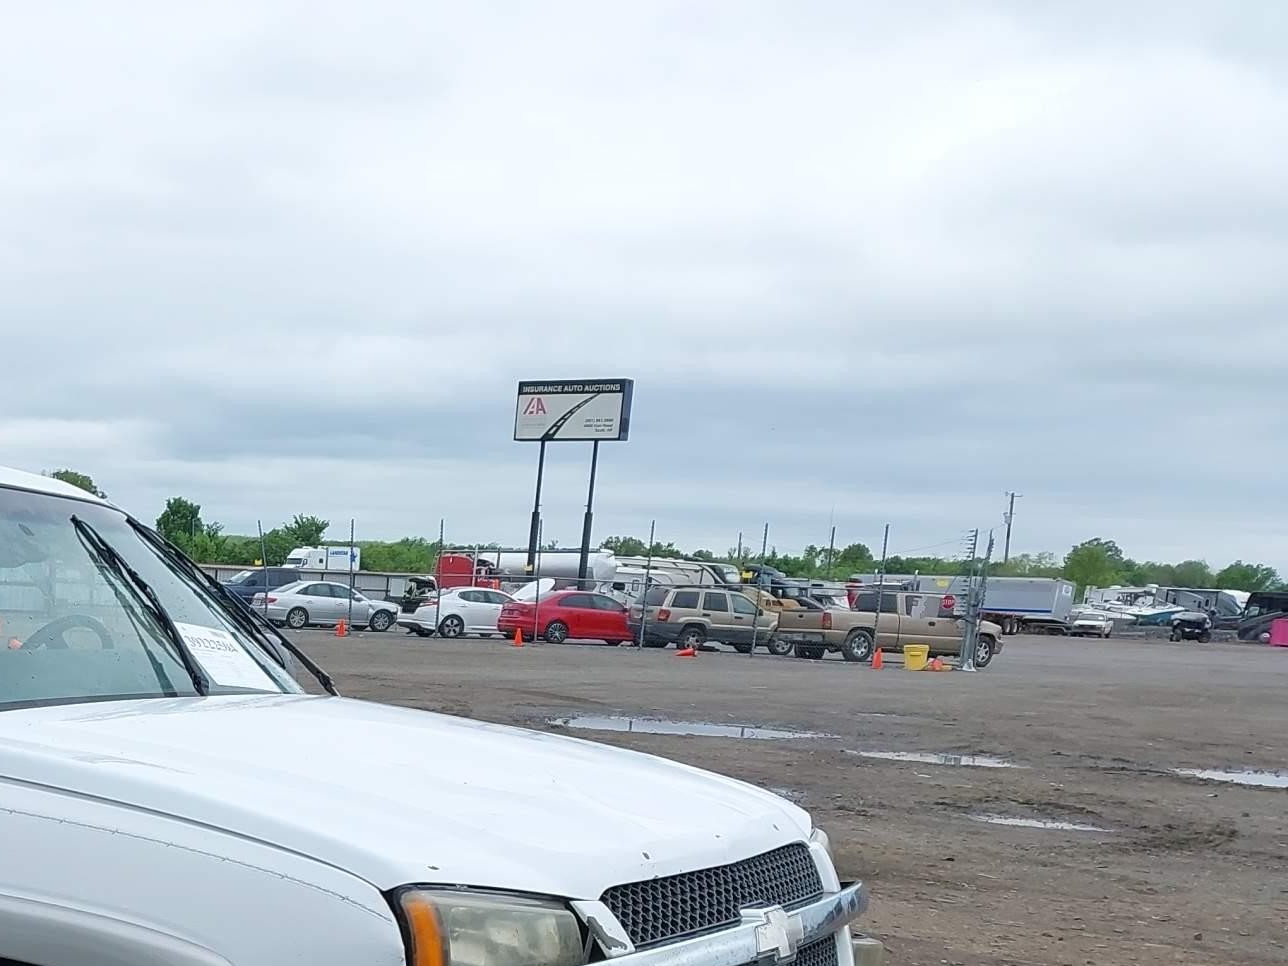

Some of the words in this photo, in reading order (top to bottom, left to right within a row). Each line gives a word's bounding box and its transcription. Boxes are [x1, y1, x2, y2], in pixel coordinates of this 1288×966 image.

[522, 385, 563, 393] INSURANCE
[563, 384, 583, 392] AUTO
[583, 383, 621, 392] AUCTIONS
